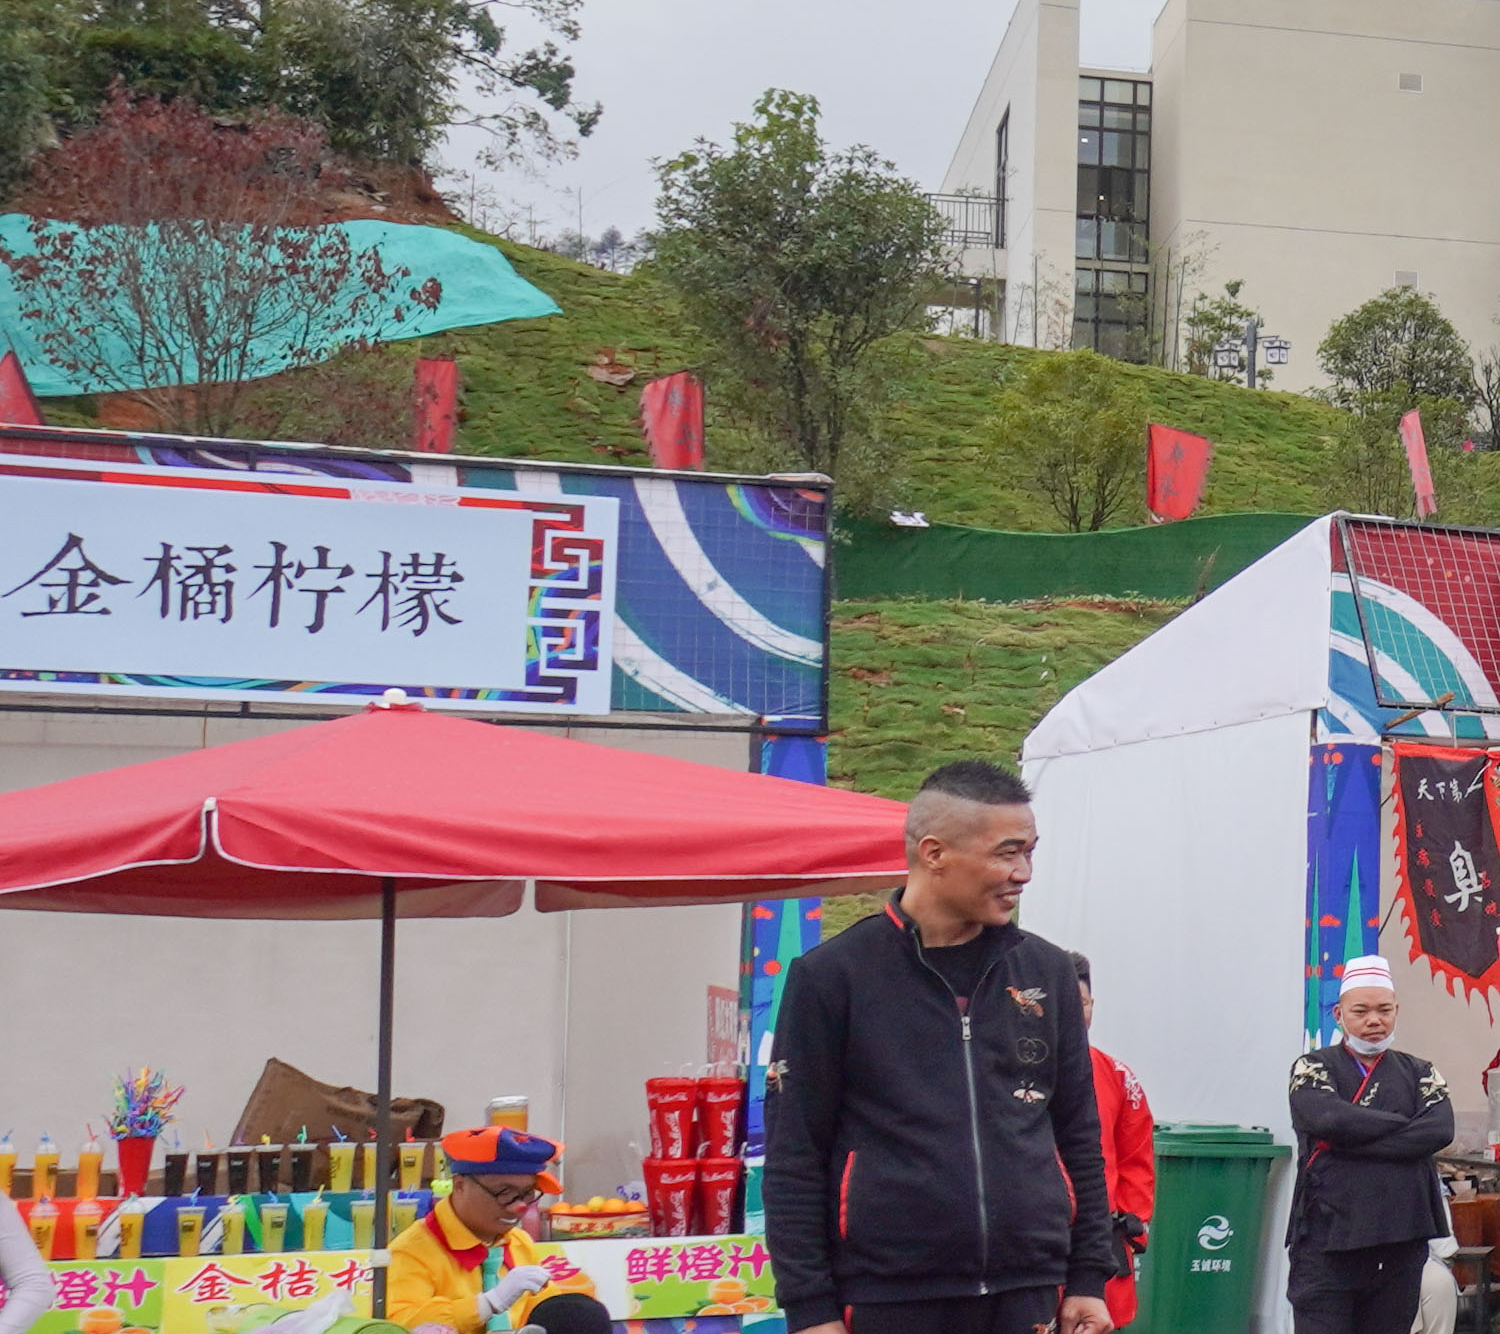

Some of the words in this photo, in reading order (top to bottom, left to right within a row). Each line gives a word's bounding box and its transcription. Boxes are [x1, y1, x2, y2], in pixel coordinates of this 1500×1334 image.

[1, 532, 465, 637] 金橘柠檬
[626, 1242, 771, 1283] 鲜橙汁
